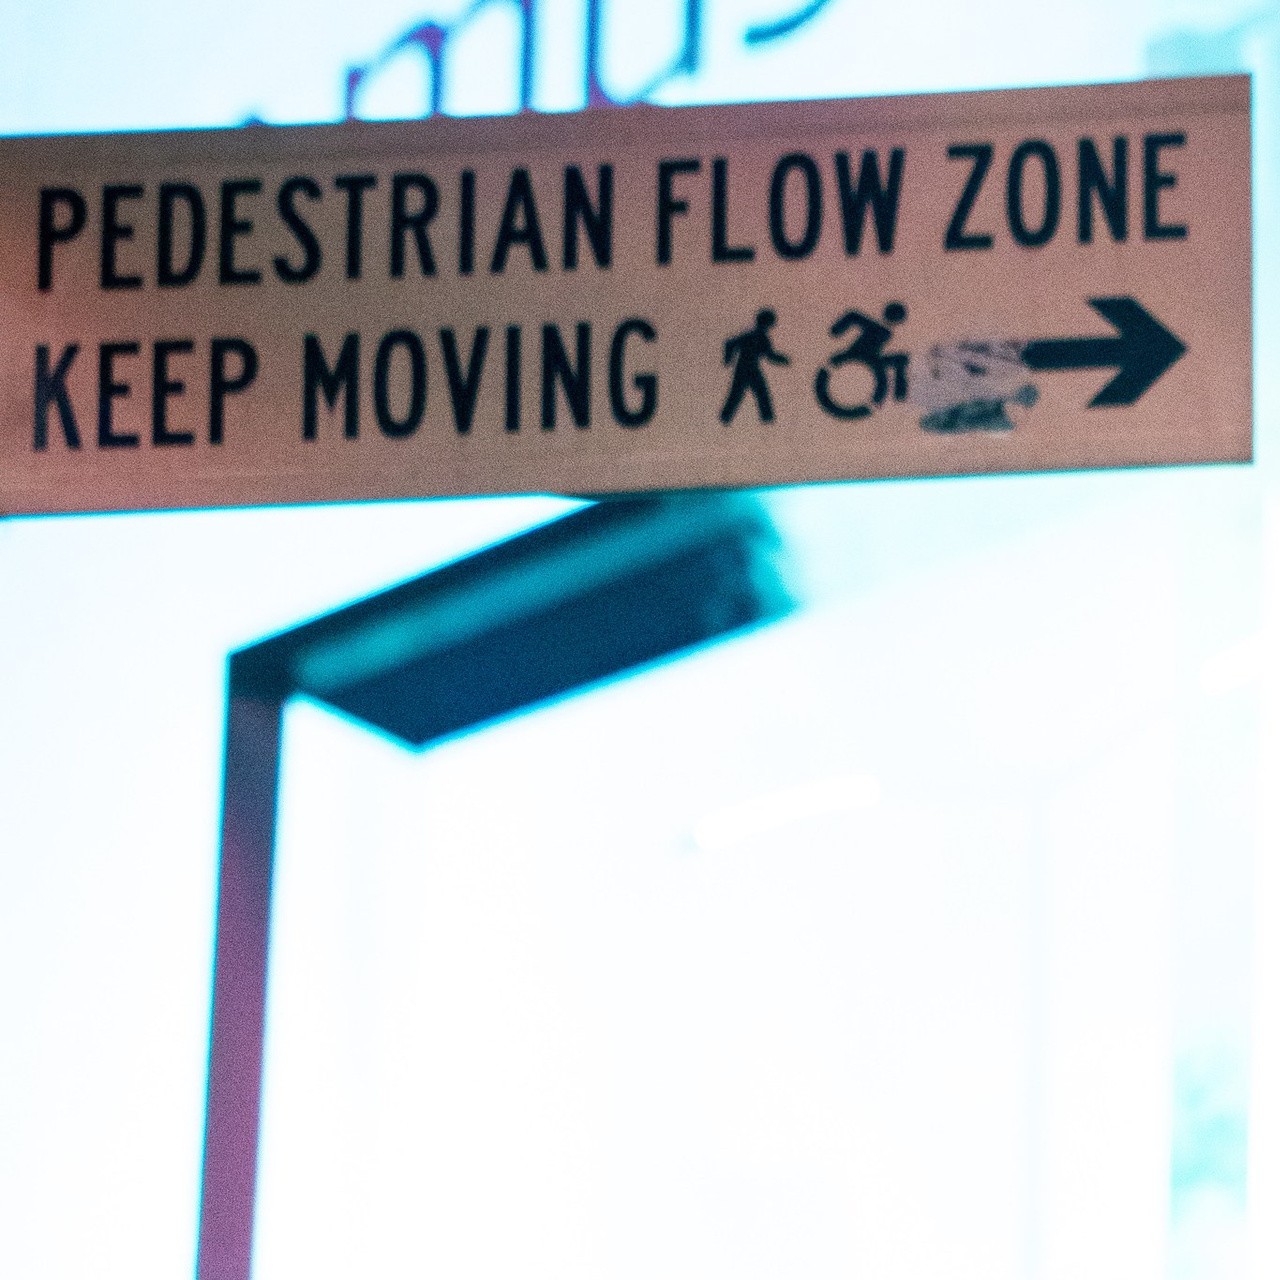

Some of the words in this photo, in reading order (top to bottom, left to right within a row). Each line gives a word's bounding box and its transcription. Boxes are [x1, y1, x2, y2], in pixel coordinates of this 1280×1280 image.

[36, 162, 614, 293] PEDESTRIAN
[656, 147, 905, 266] FLOW
[944, 132, 1188, 251] ZONE
[33, 335, 260, 450] KEEP
[302, 317, 658, 441] MOVING
